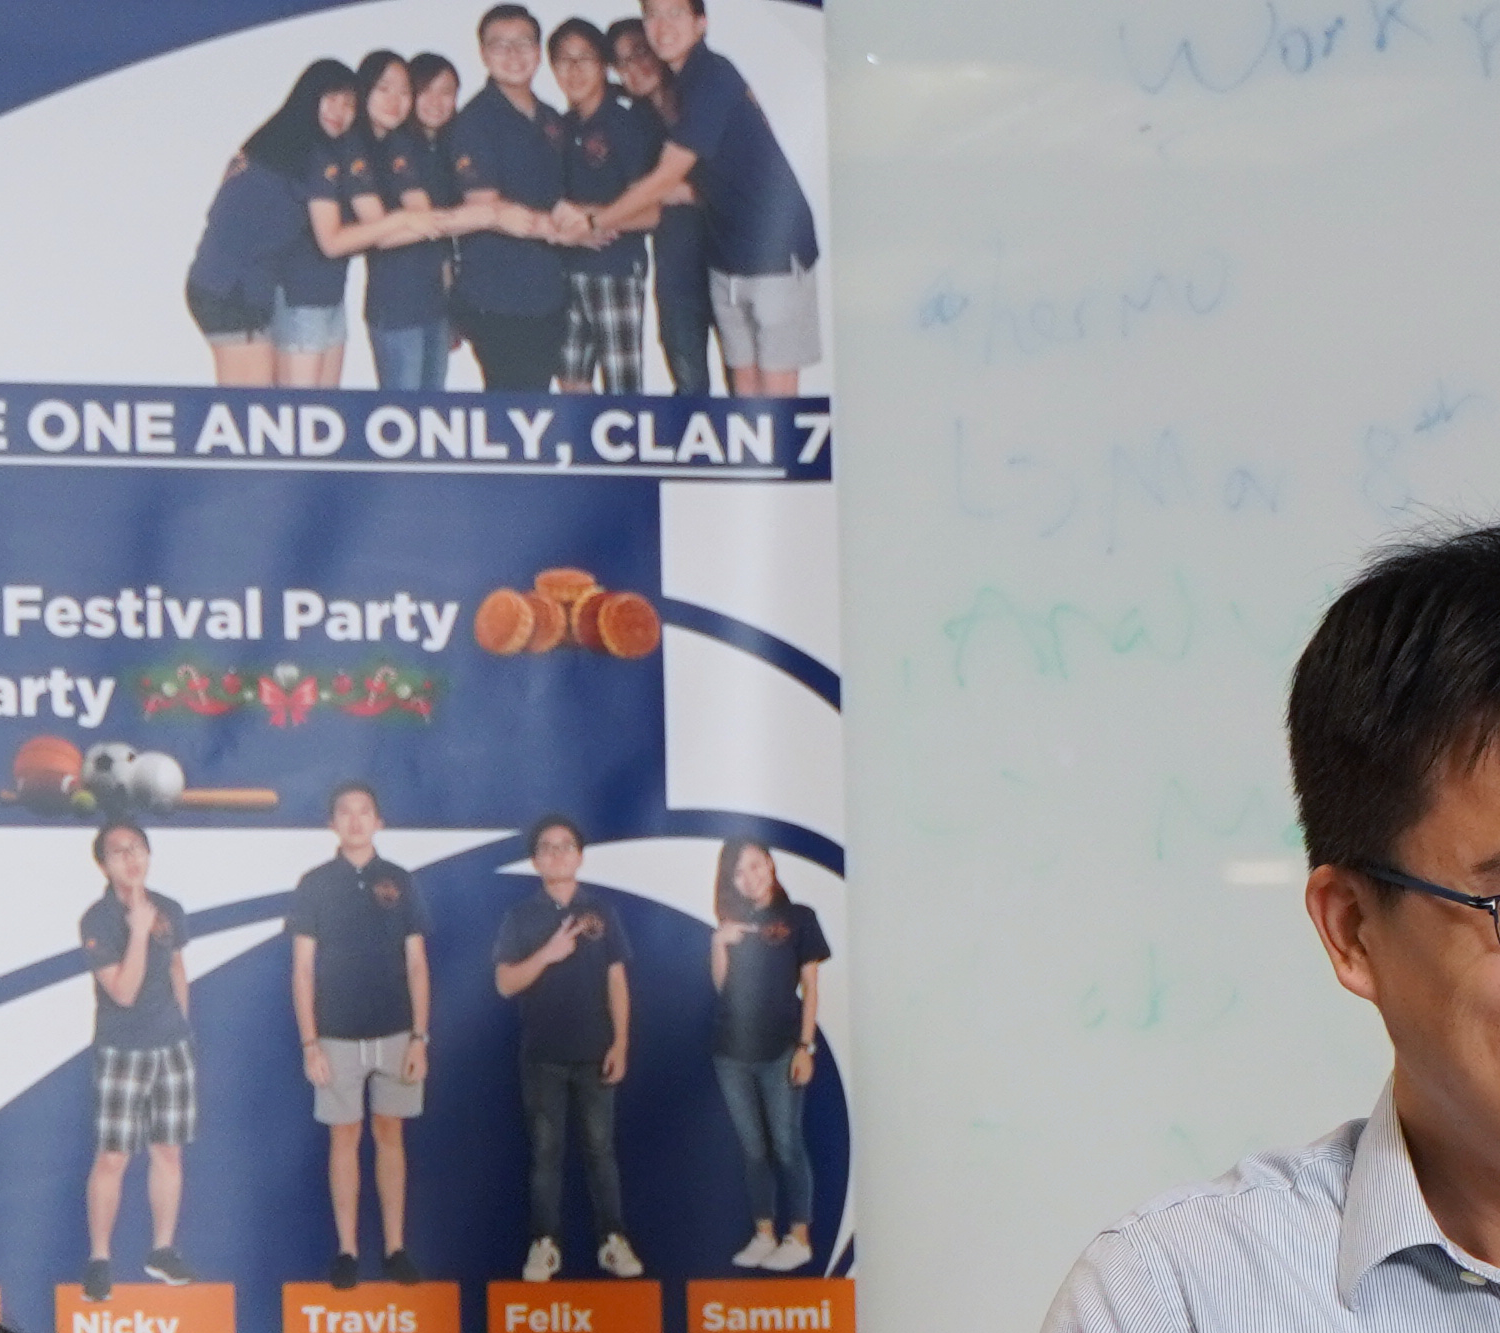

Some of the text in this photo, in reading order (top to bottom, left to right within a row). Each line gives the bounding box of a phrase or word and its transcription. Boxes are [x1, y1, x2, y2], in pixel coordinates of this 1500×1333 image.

[28, 399, 175, 458] ONE
[195, 403, 345, 460] AND
[364, 406, 574, 471] ONLY,
[590, 411, 775, 467] CLAN
[794, 414, 831, 466] 7
[3, 584, 262, 642] Festival
[281, 592, 459, 654] Party
[504, 1301, 593, 1333] Felix
[701, 1299, 832, 1333] Sammi
